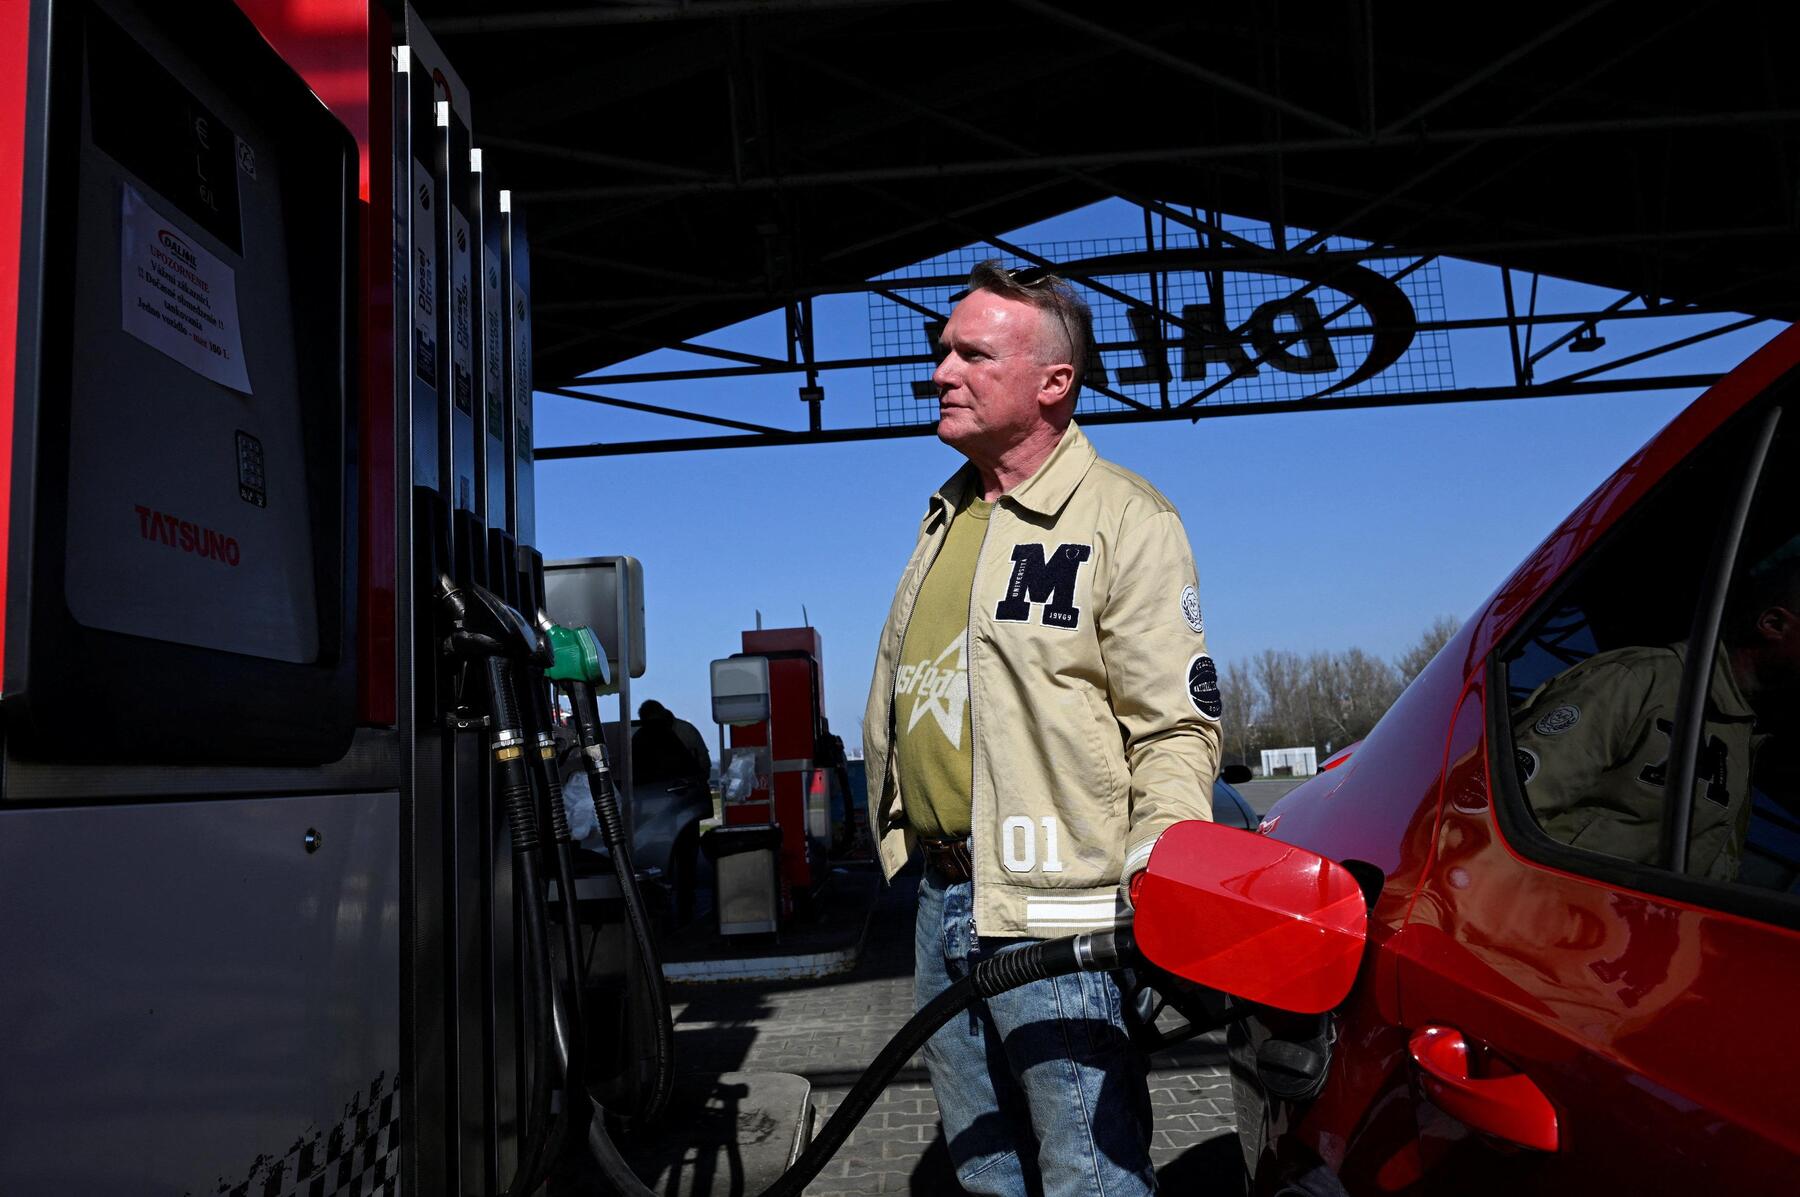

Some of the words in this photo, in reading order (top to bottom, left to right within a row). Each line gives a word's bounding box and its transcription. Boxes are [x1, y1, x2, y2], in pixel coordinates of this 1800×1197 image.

[150, 244, 209, 291] UPOZORNENIE
[418, 247, 426, 311] Diesel
[134, 504, 240, 566] TATSUNO
[994, 543, 1092, 628] M
[1003, 815, 1062, 873] 01
